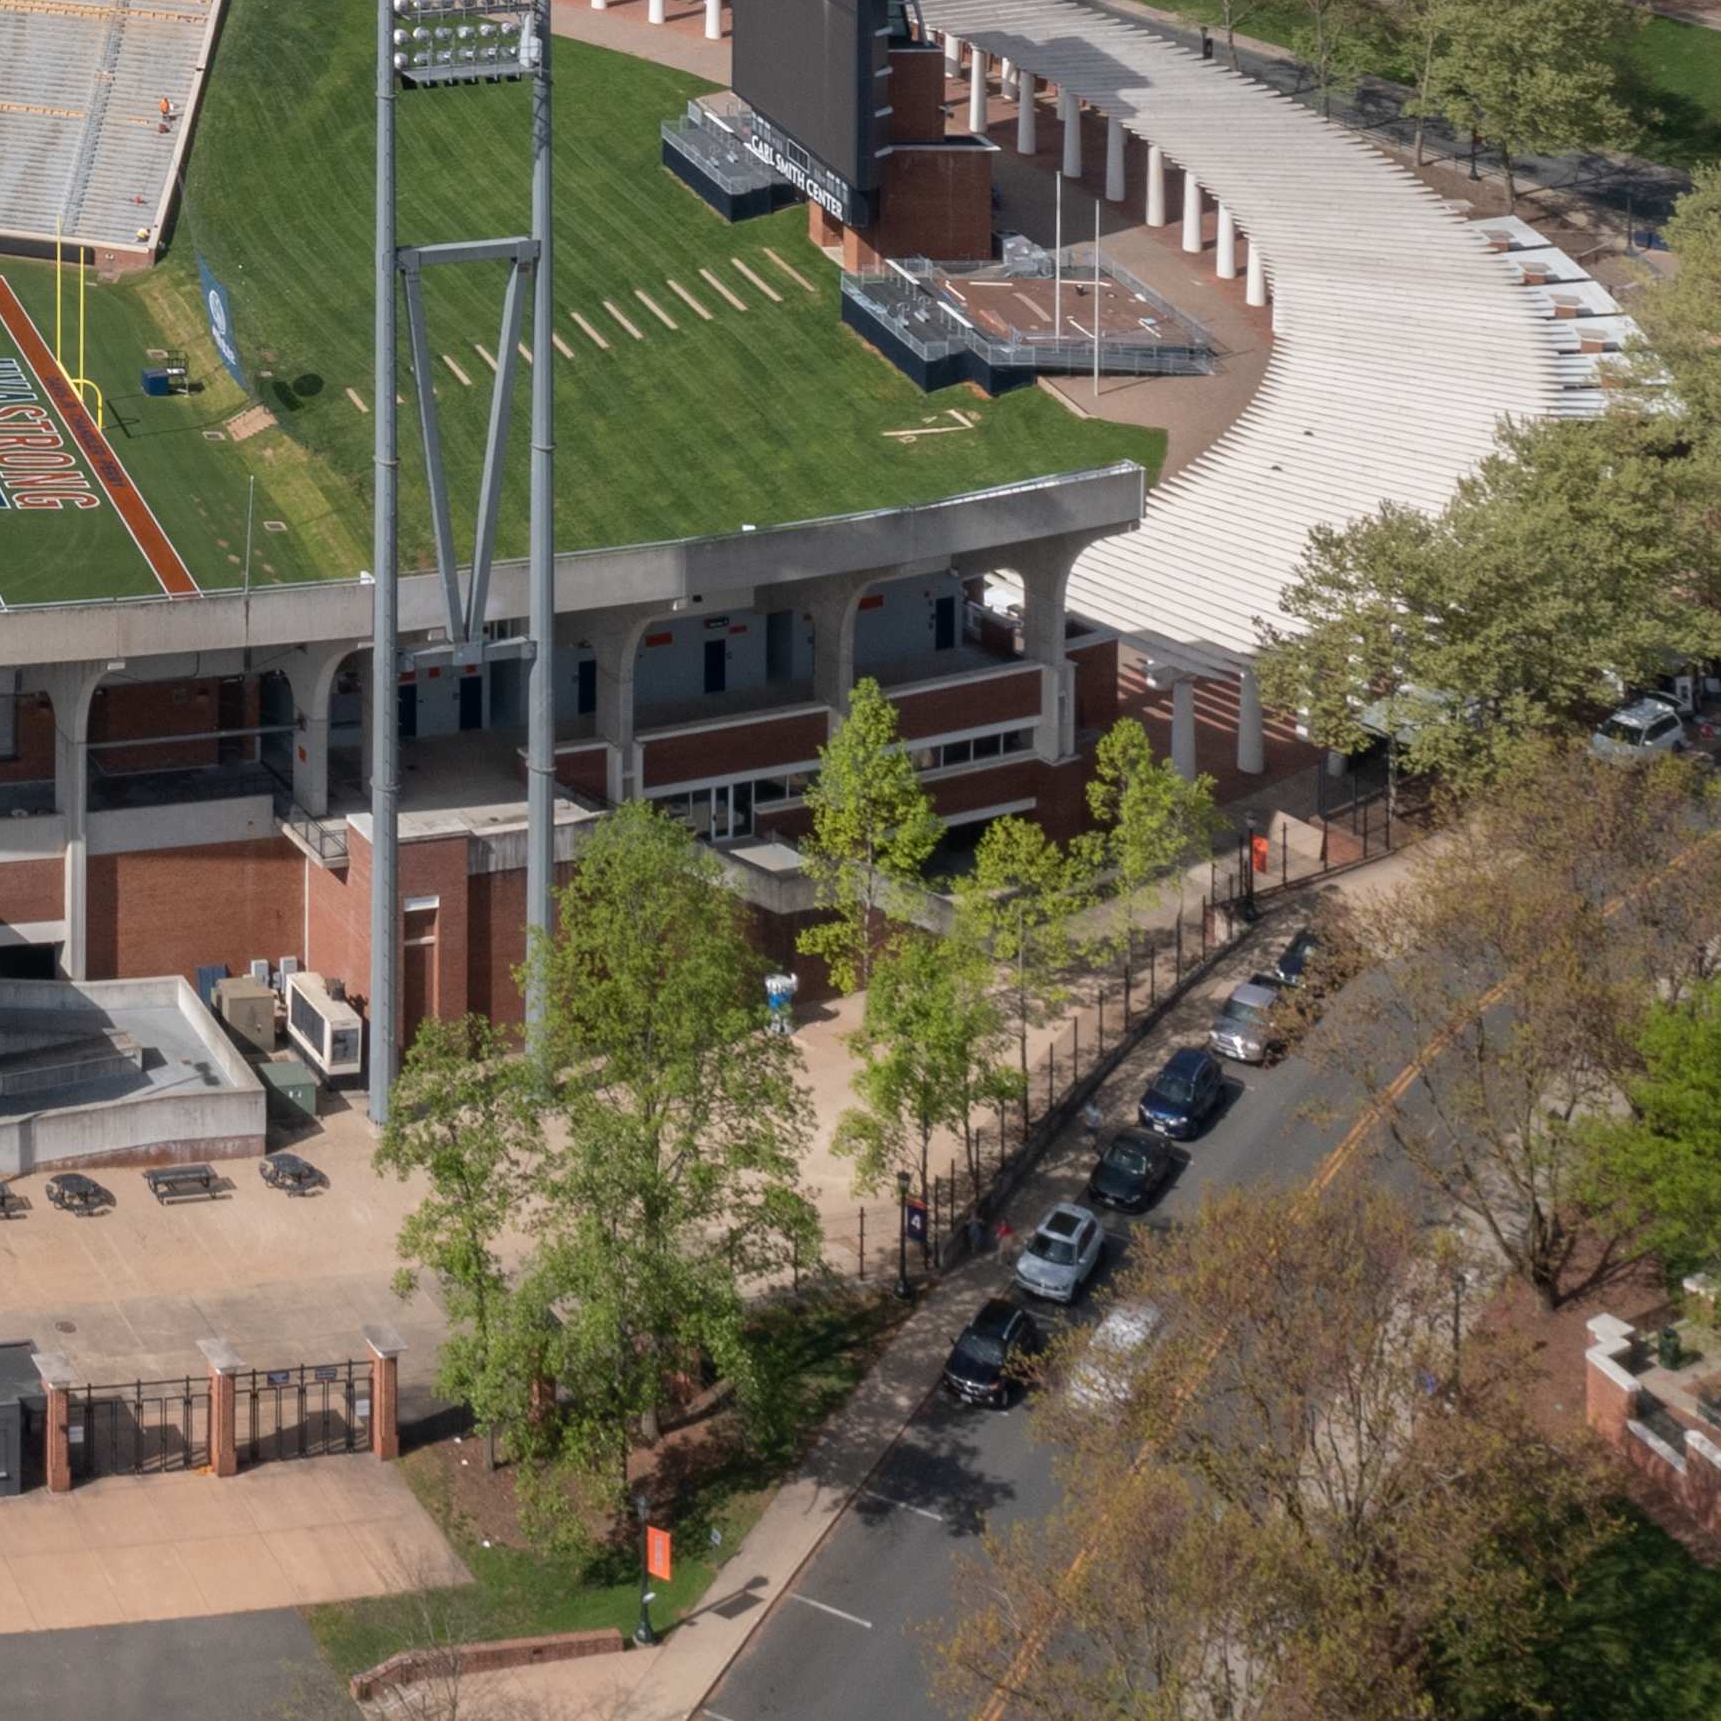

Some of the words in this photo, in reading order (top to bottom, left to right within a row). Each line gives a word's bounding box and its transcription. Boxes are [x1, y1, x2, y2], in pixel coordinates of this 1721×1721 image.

[751, 135, 775, 166] CARL
[775, 153, 806, 191] SMITH
[806, 178, 844, 221] CENTER
[911, 1214, 921, 1230] 4
